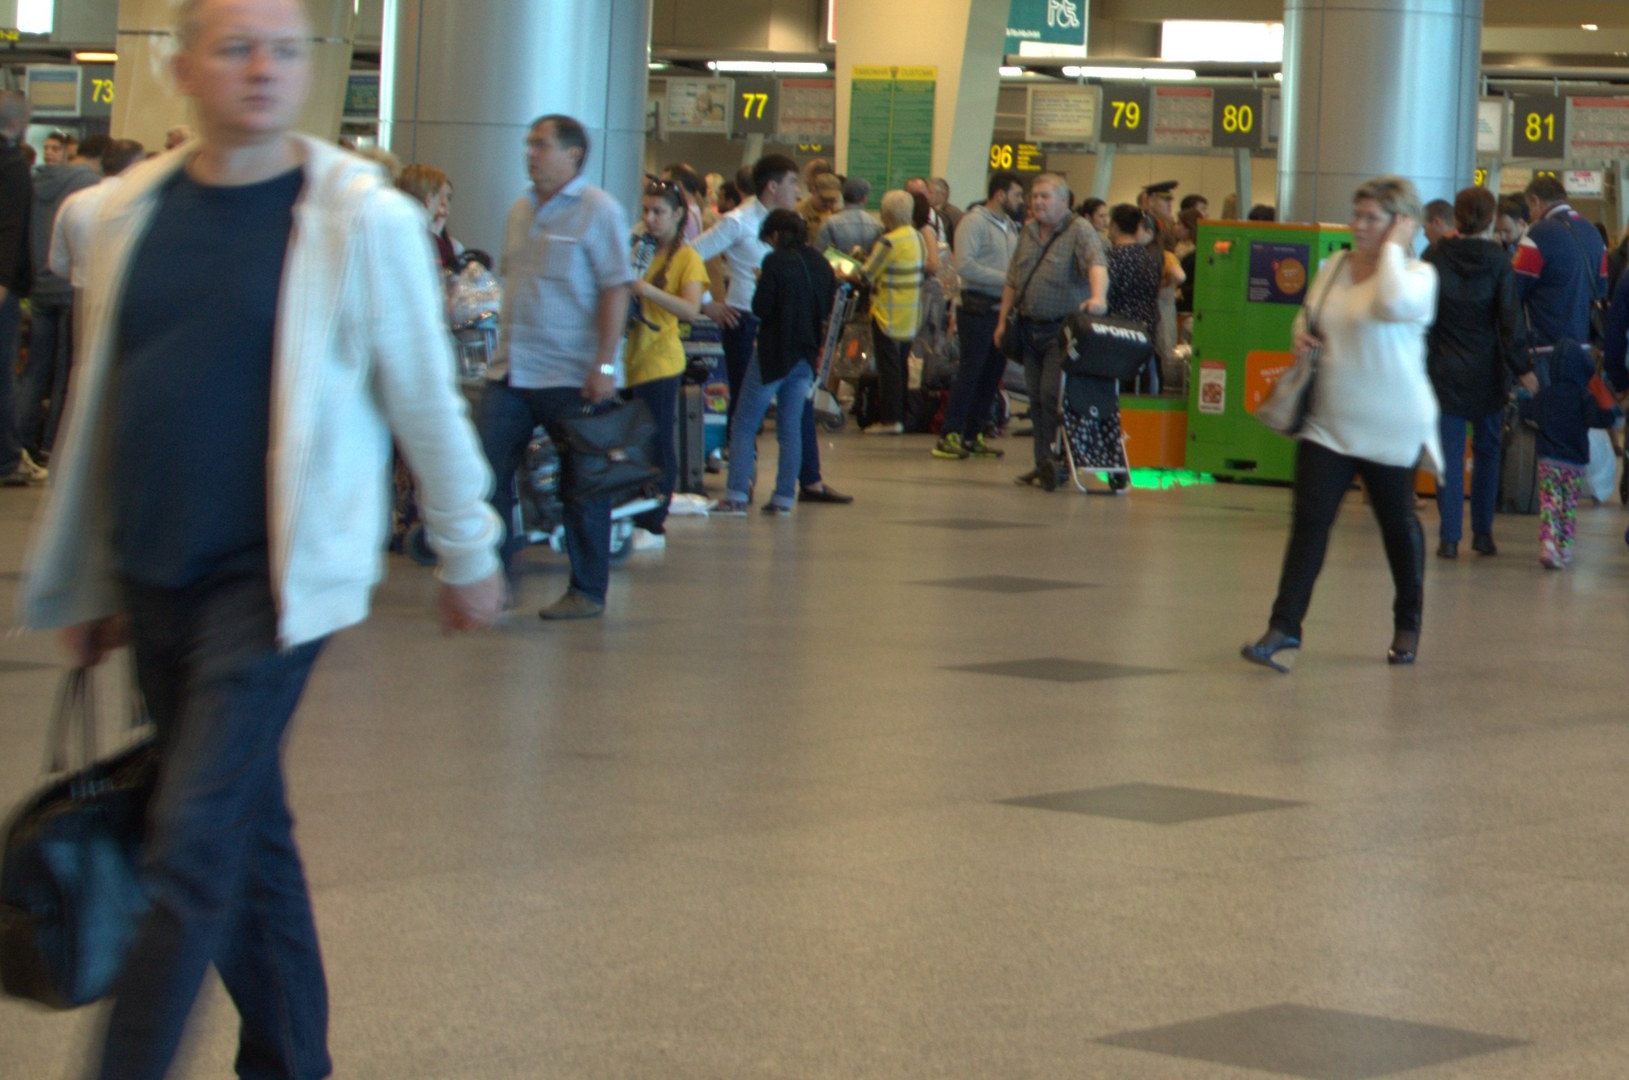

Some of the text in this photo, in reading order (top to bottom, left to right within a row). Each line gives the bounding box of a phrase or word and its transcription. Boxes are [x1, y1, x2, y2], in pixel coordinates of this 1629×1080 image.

[91, 79, 114, 103] 73
[742, 93, 768, 119] 77
[1111, 101, 1140, 129] 79
[1222, 104, 1253, 133] 80
[1525, 112, 1555, 142] 81
[990, 144, 1012, 169] 96
[1091, 322, 1147, 343] SPORTS
